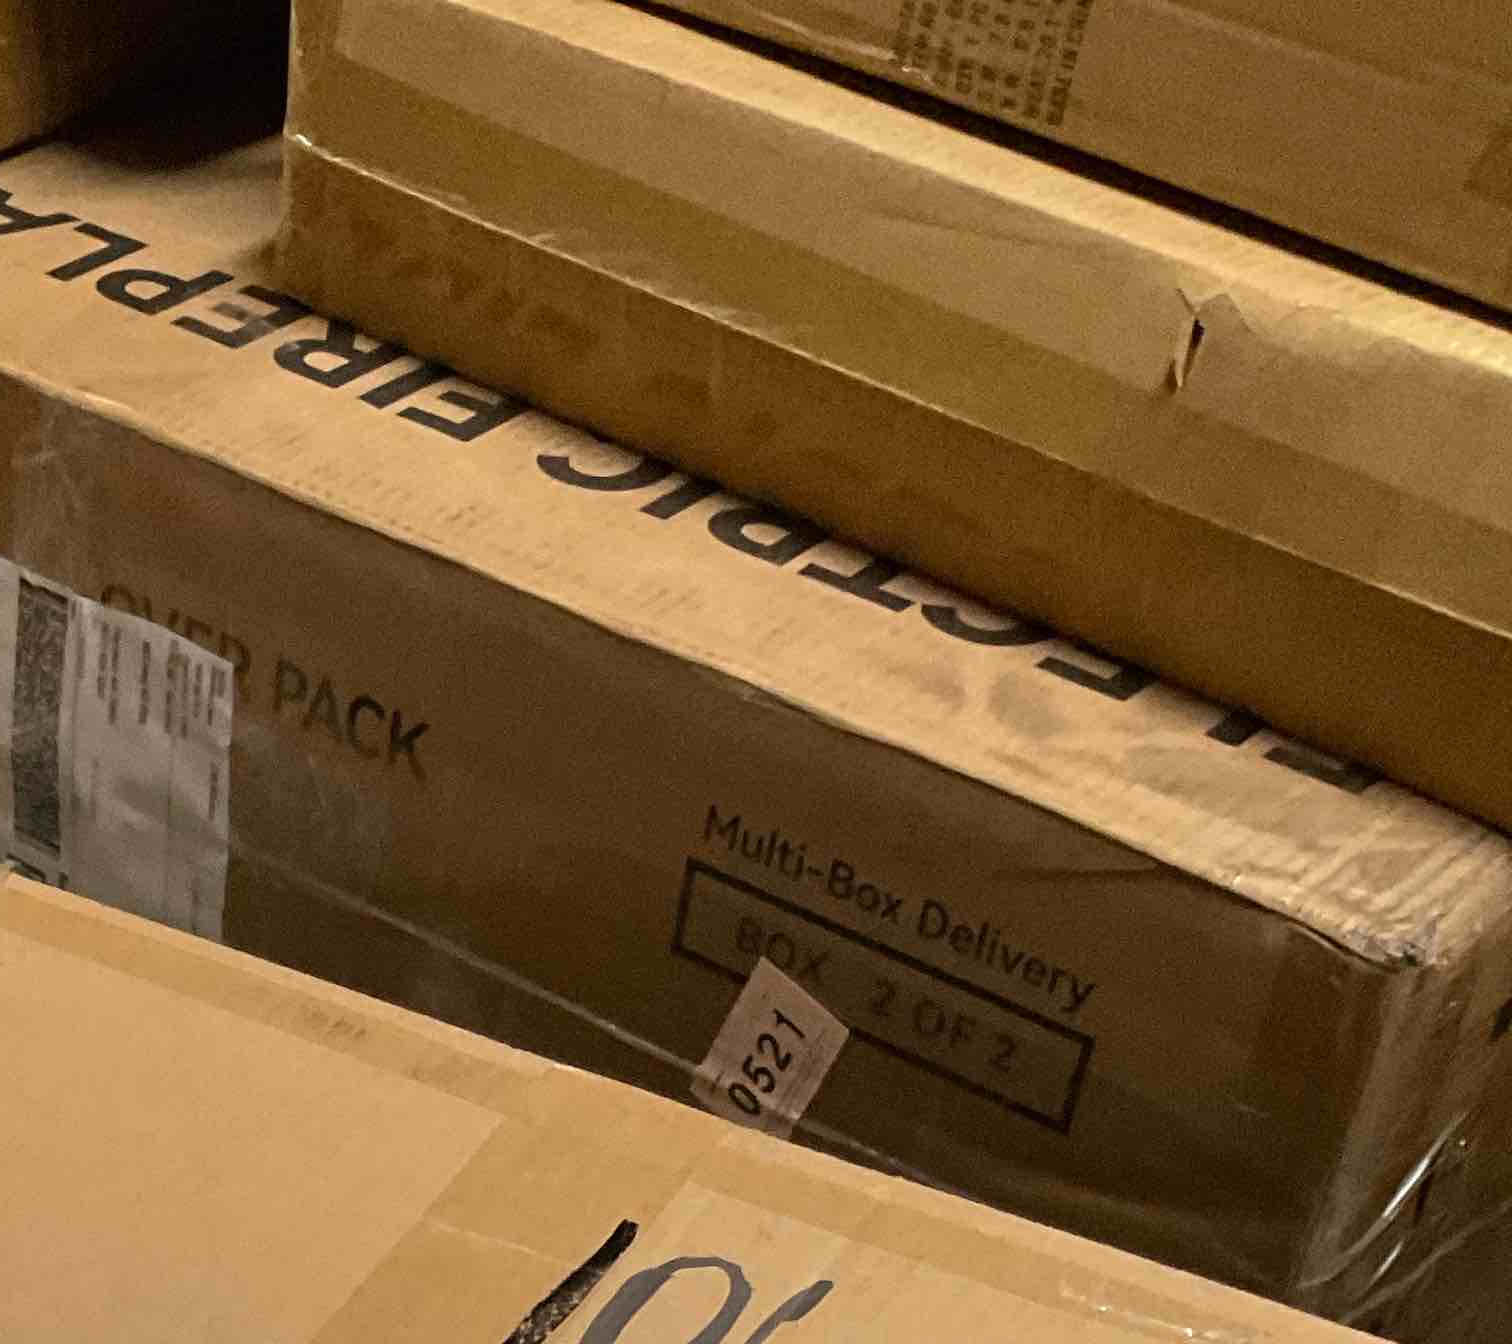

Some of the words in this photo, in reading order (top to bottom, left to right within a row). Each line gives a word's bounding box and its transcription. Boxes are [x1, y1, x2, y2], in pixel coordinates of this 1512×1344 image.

[272, 662, 430, 778] PACK
[704, 805, 907, 925] Multi-Box
[917, 899, 1096, 1012] Delivery
[726, 1009, 805, 1116] 0521
